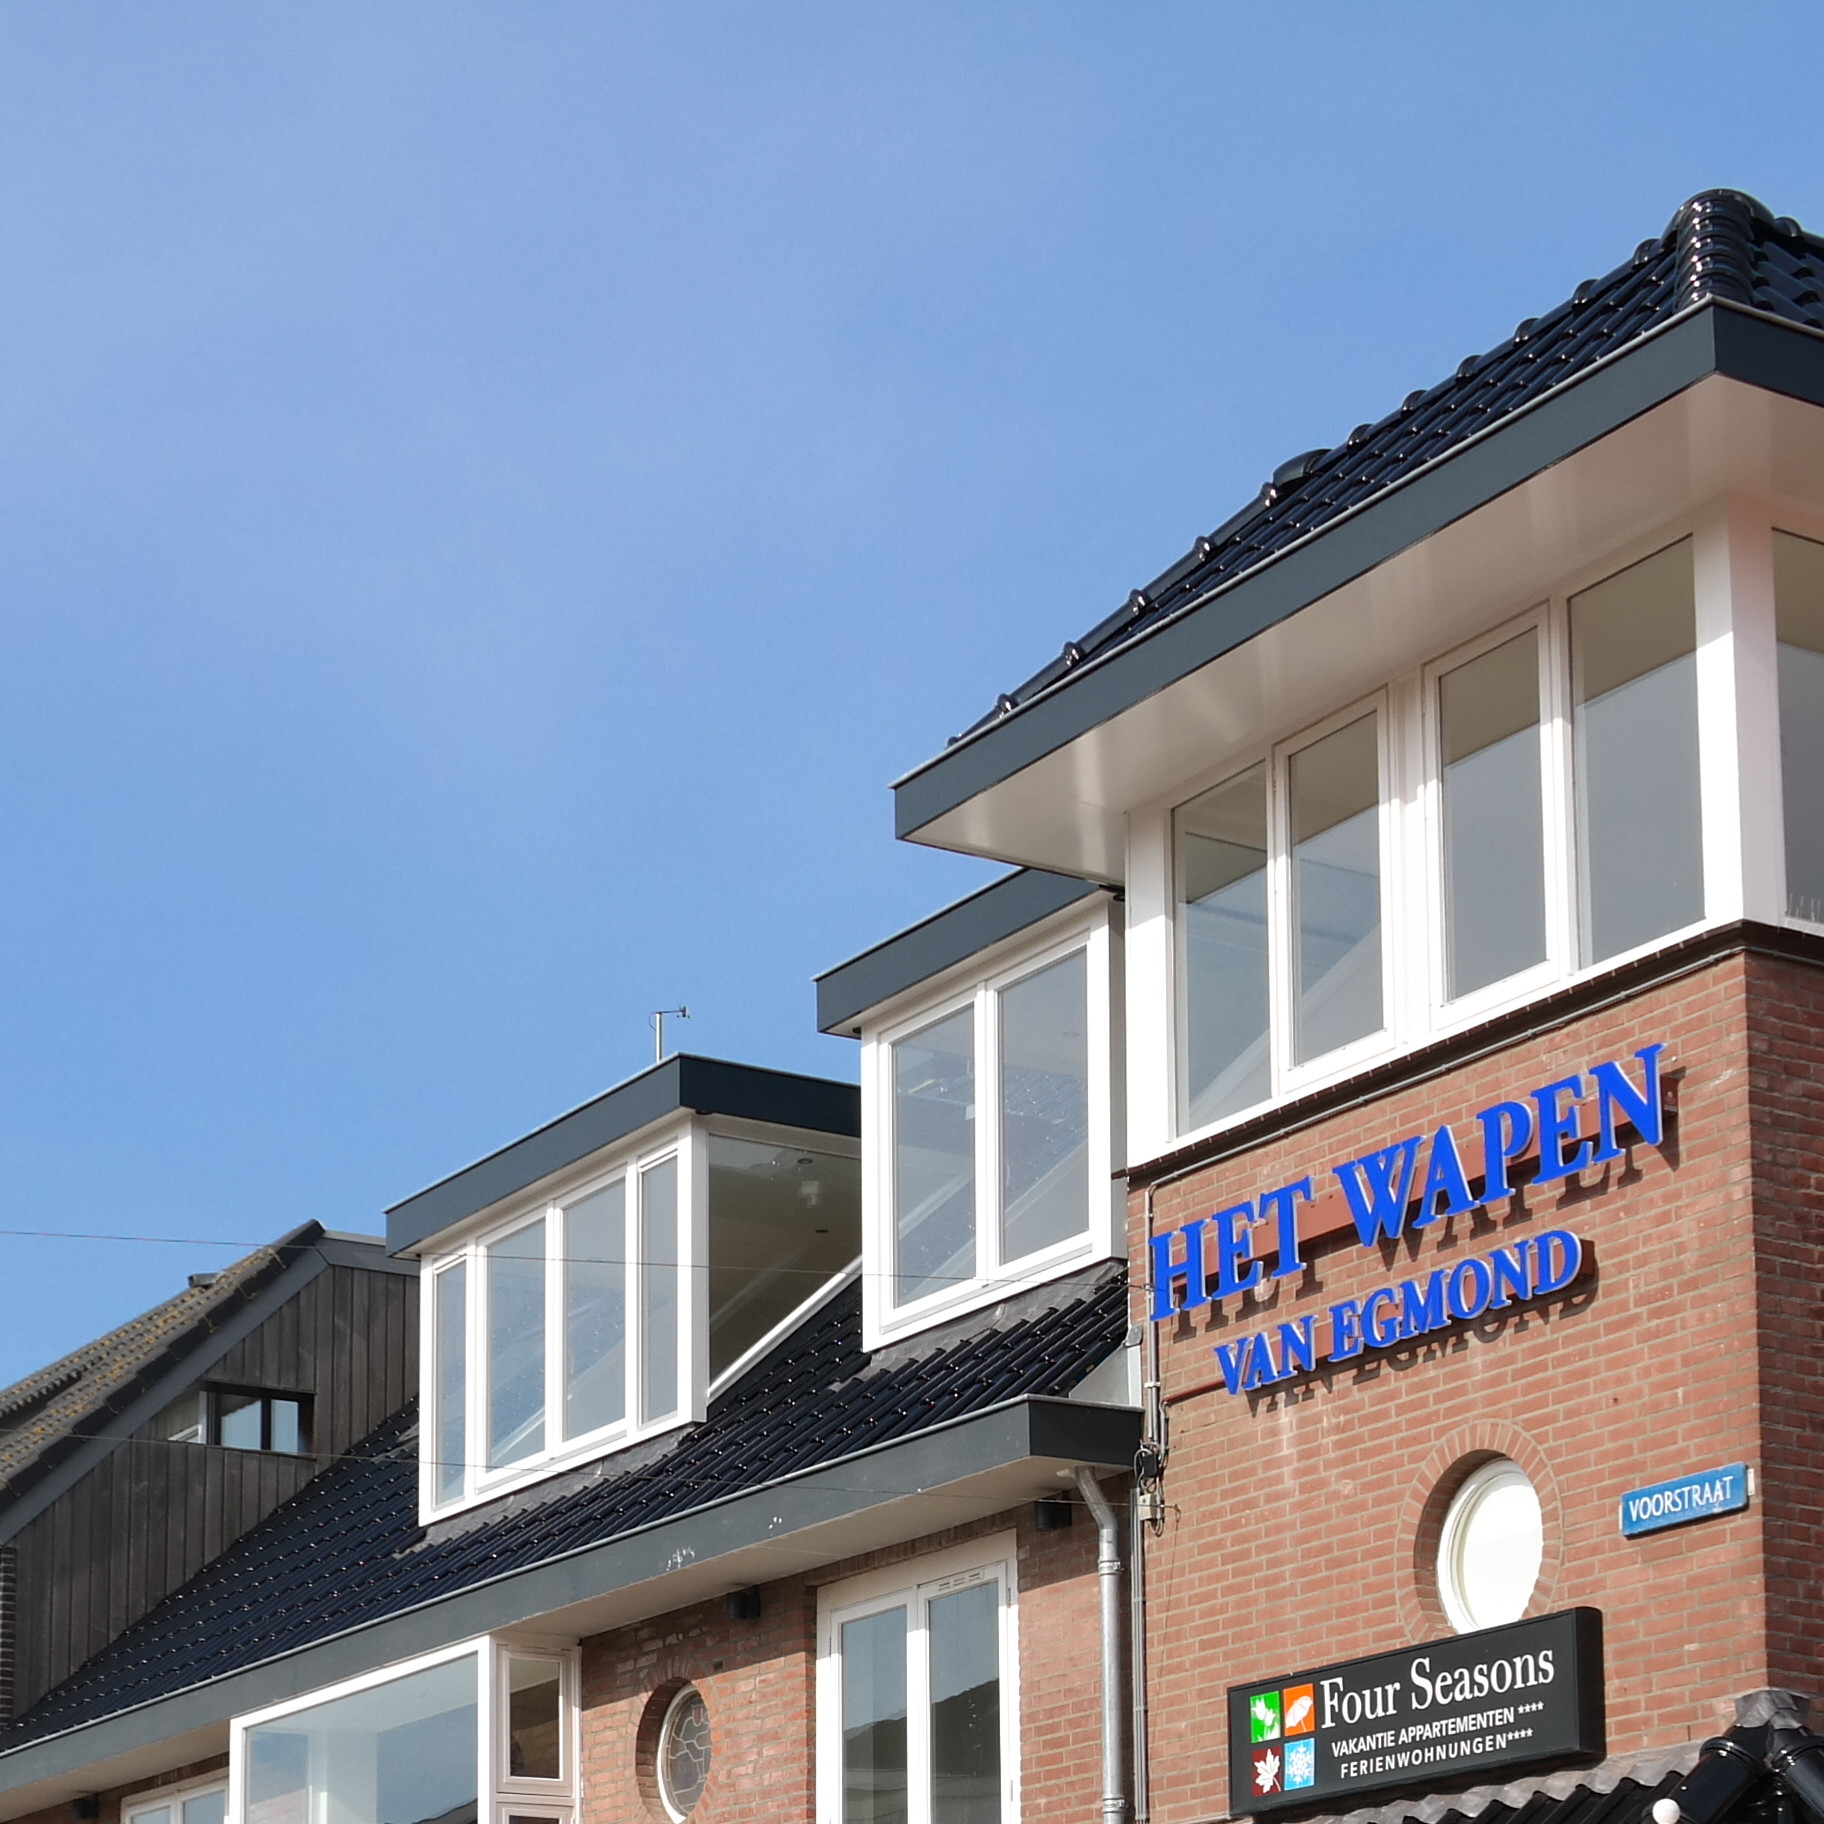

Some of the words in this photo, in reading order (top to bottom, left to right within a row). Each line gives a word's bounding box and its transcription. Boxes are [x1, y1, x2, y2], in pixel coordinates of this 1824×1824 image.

[1148, 1177, 1314, 1321] HET
[1332, 1042, 1667, 1248] WAPEN
[1213, 1315, 1316, 1396] VAN
[1328, 1228, 1582, 1363] EGMOND
[1629, 1475, 1734, 1522] VOORSTRAAT
[1320, 1676, 1401, 1729] Four
[1409, 1648, 1555, 1710] Seasons
[1331, 1730, 1396, 1758] VAKANTIE
[1398, 1706, 1515, 1746] APPARTEMENTEN
[1340, 1732, 1508, 1779] FERIENWOHNUNGEN
